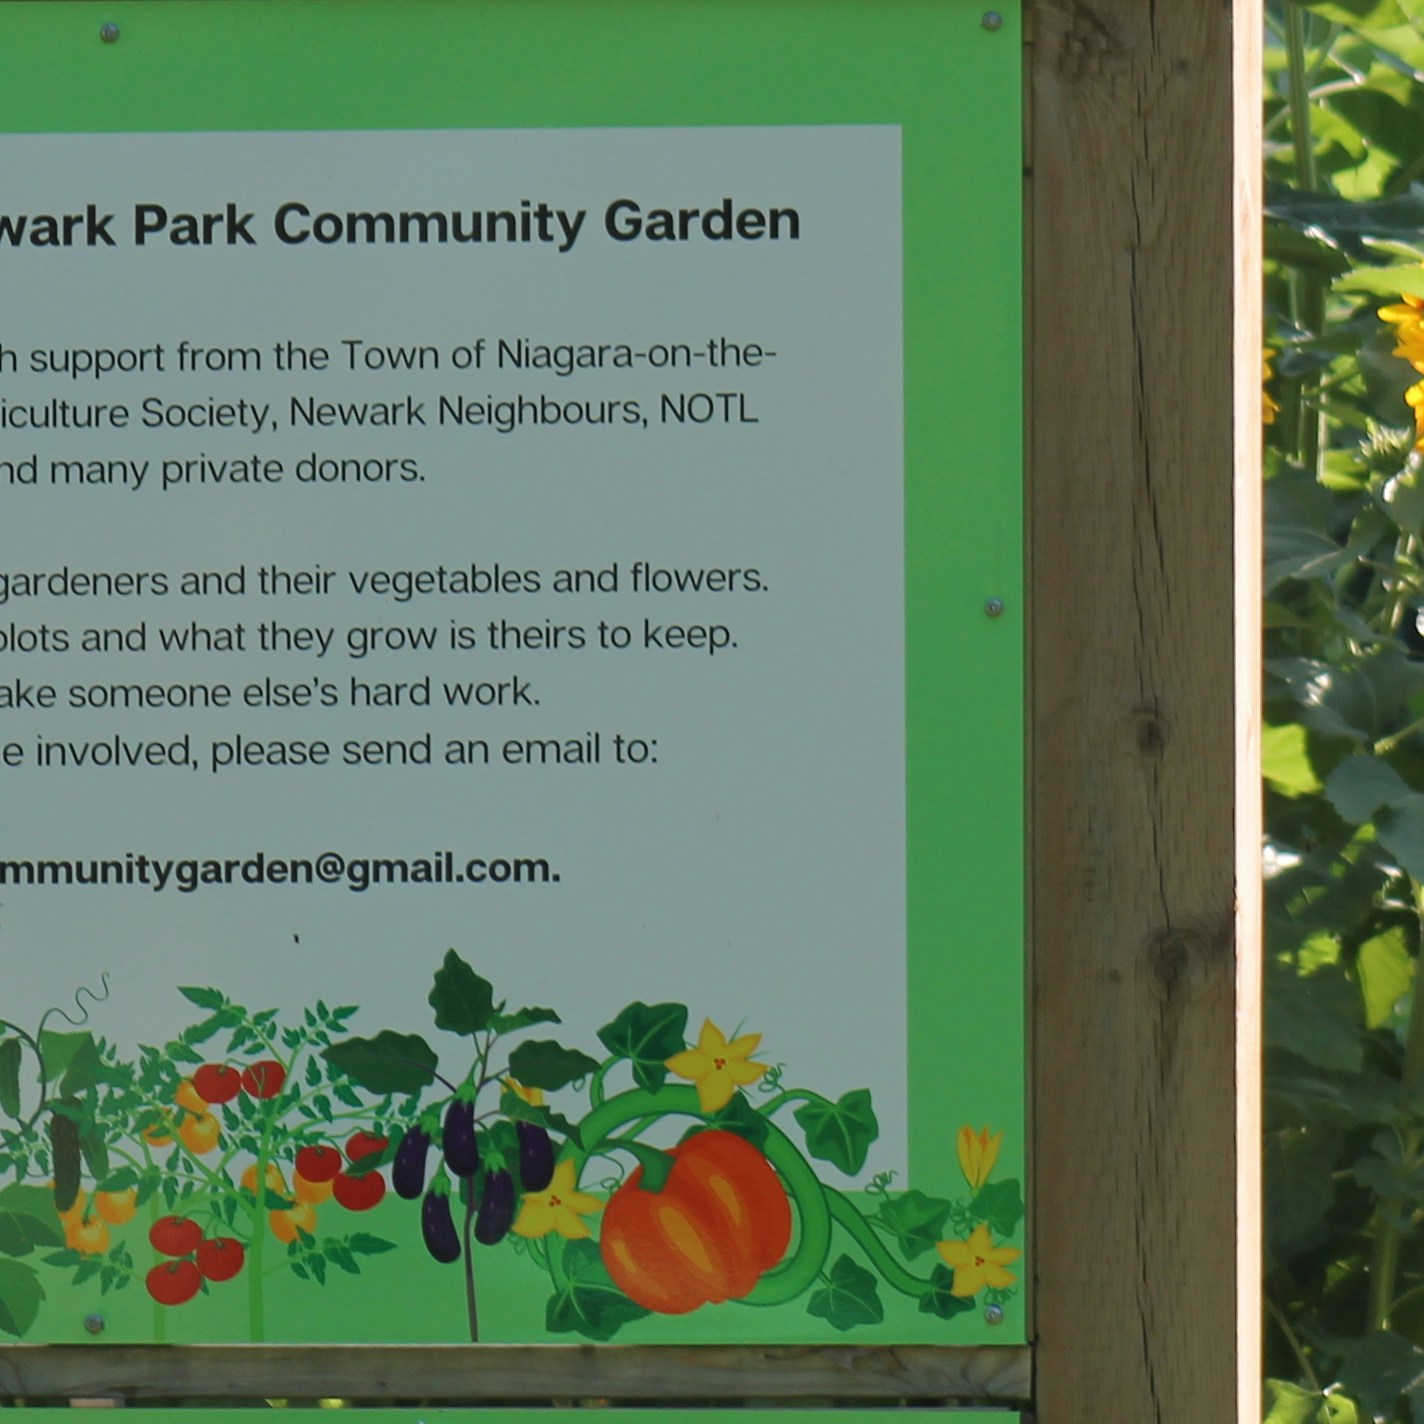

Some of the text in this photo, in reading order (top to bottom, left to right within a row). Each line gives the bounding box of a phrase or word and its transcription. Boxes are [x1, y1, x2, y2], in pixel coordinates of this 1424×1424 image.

[134, 202, 257, 247] Park
[274, 199, 587, 254] Community
[604, 197, 800, 242] Garden
[29, 343, 166, 380] support
[176, 340, 261, 372] from
[273, 339, 330, 371] the
[340, 339, 439, 371] Town
[451, 338, 486, 370] of
[498, 336, 777, 377] Niagara-on-the-
[141, 396, 278, 435] Society,
[290, 394, 427, 427] Newark
[439, 394, 648, 434] Neighbours,
[660, 392, 760, 424] NOTL
[50, 460, 150, 492] many
[162, 452, 284, 492] private
[295, 451, 426, 483] donors.
[180, 564, 246, 596] and
[257, 563, 337, 596] their
[348, 562, 542, 603] vegetables
[552, 561, 619, 594] and
[630, 561, 769, 593] flowers.
[81, 621, 147, 653] and
[158, 620, 246, 652] what
[257, 620, 335, 659] they
[346, 626, 438, 660] grow
[450, 618, 476, 650] is
[487, 618, 587, 650] theirs
[597, 620, 632, 649] to
[644, 617, 738, 657] keep.
[68, 684, 232, 709] someone
[350, 675, 431, 707] hard
[442, 674, 540, 707] work.
[37, 733, 199, 772] involved,
[211, 733, 330, 774] please
[342, 732, 432, 766] send
[444, 740, 489, 765] an
[502, 731, 600, 765] email
[612, 733, 658, 764] to:
